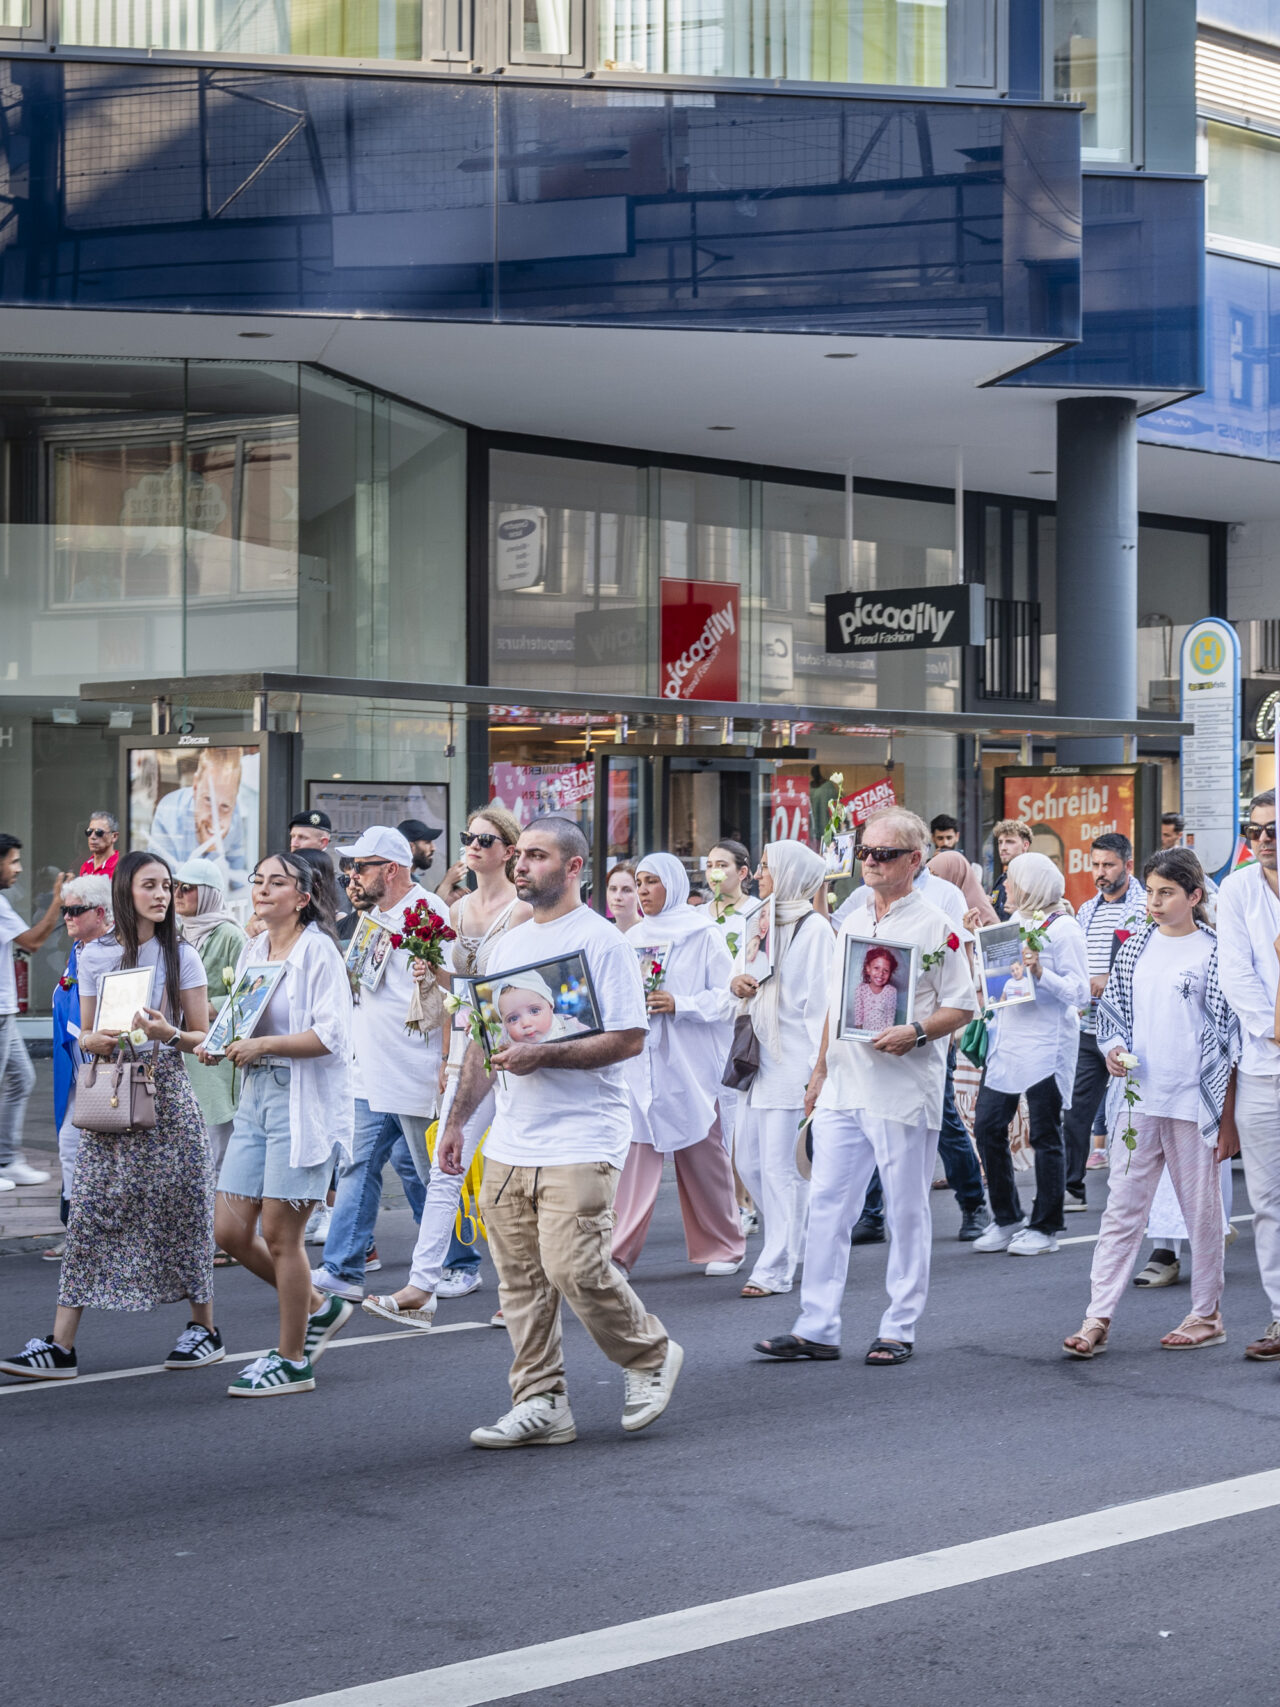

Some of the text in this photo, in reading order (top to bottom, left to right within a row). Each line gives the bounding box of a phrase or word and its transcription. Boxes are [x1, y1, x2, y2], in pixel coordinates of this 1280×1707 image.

[838, 597, 954, 644] piccadilly
[853, 632, 914, 645] Trend Fashion
[663, 601, 735, 699] piccadilly
[1017, 785, 1109, 823] Schreib!
[1068, 849, 1093, 874] Bu
